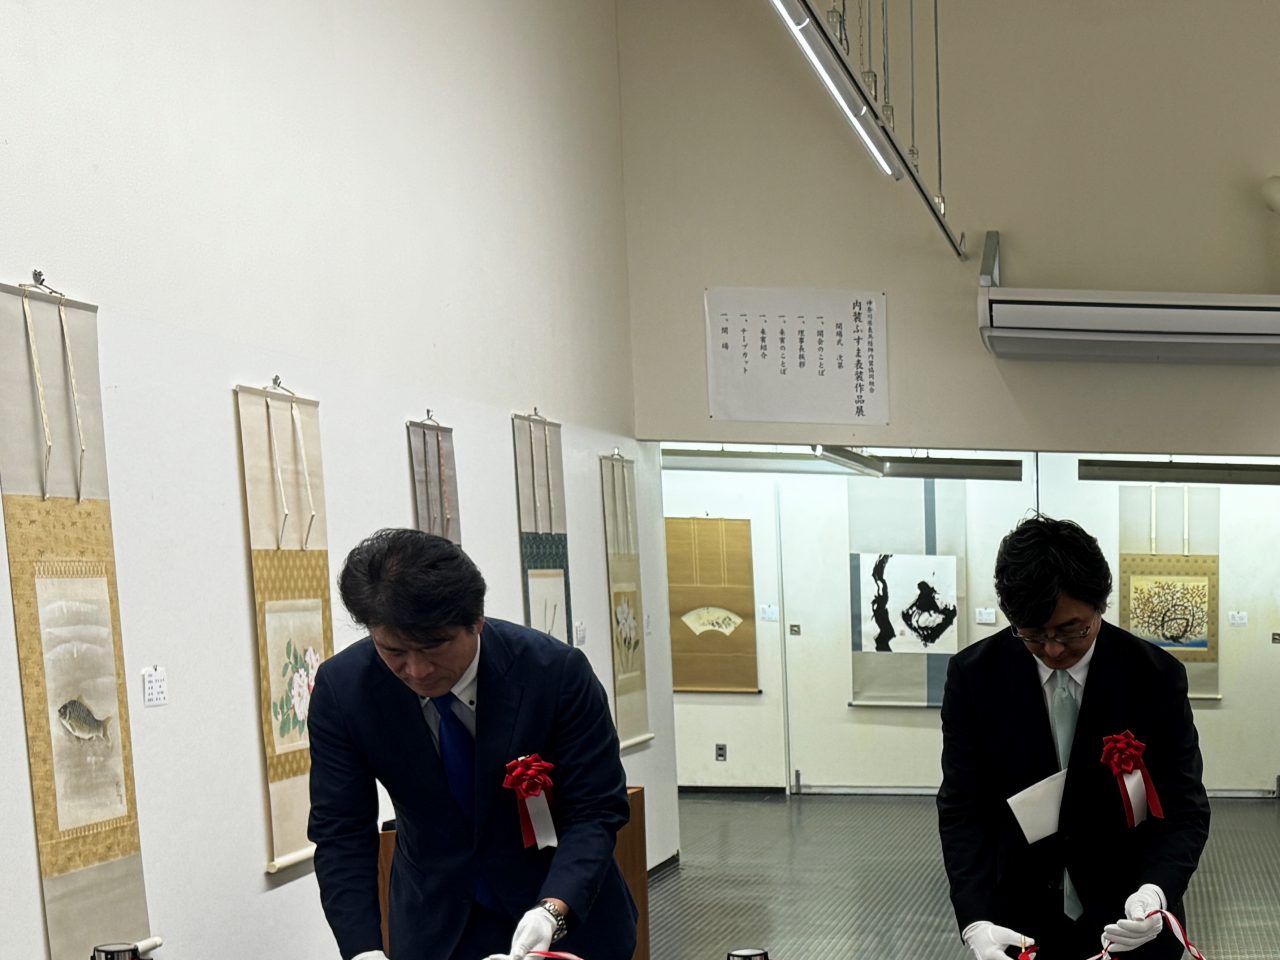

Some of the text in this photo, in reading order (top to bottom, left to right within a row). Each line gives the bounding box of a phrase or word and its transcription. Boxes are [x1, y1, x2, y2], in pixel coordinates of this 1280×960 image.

[852, 299, 866, 417] 内装ふすま表装作品展
